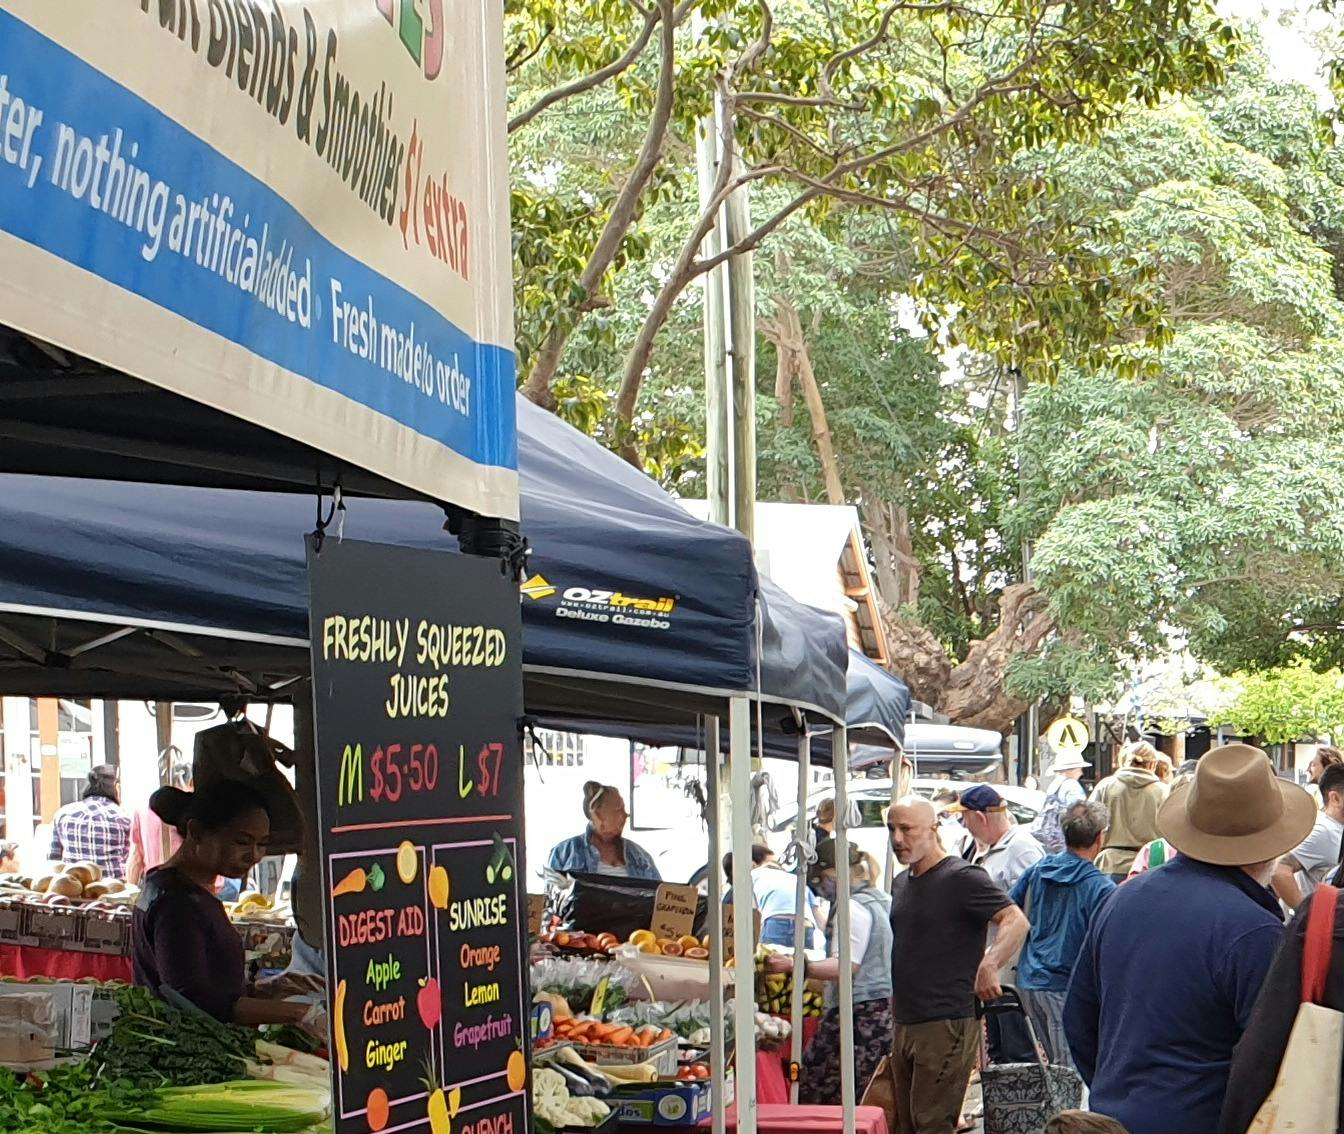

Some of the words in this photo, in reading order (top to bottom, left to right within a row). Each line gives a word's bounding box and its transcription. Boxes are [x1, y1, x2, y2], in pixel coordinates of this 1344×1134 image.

[297, 7, 318, 146] &
[315, 28, 404, 226] Smoothies
[423, 172, 469, 281] extra
[51, 122, 170, 262] nothing
[168, 192, 268, 294] artificial
[258, 239, 312, 328] added
[330, 278, 378, 364] Fresh
[380, 321, 424, 388] made
[421, 341, 434, 397] to
[436, 353, 471, 417] order
[555, 607, 610, 623] Deluxe
[611, 614, 671, 630] Gazebo
[563, 587, 676, 612] OZtrail
[323, 615, 409, 667] FRESHLY
[416, 619, 506, 670] SQUEEZED
[385, 673, 449, 718] JUICES
[338, 743, 363, 807] M
[458, 744, 473, 799] L
[478, 742, 504, 798] $7
[339, 908, 395, 948] DIGEST
[397, 904, 424, 937] AID
[449, 893, 508, 932] SUNRISE
[365, 953, 401, 991] Apple
[460, 943, 501, 971] Orange
[363, 995, 406, 1027] Carrot
[464, 981, 500, 1008] Lemon
[453, 1013, 513, 1050] Grapefruit
[366, 1040, 407, 1072] Ginger
